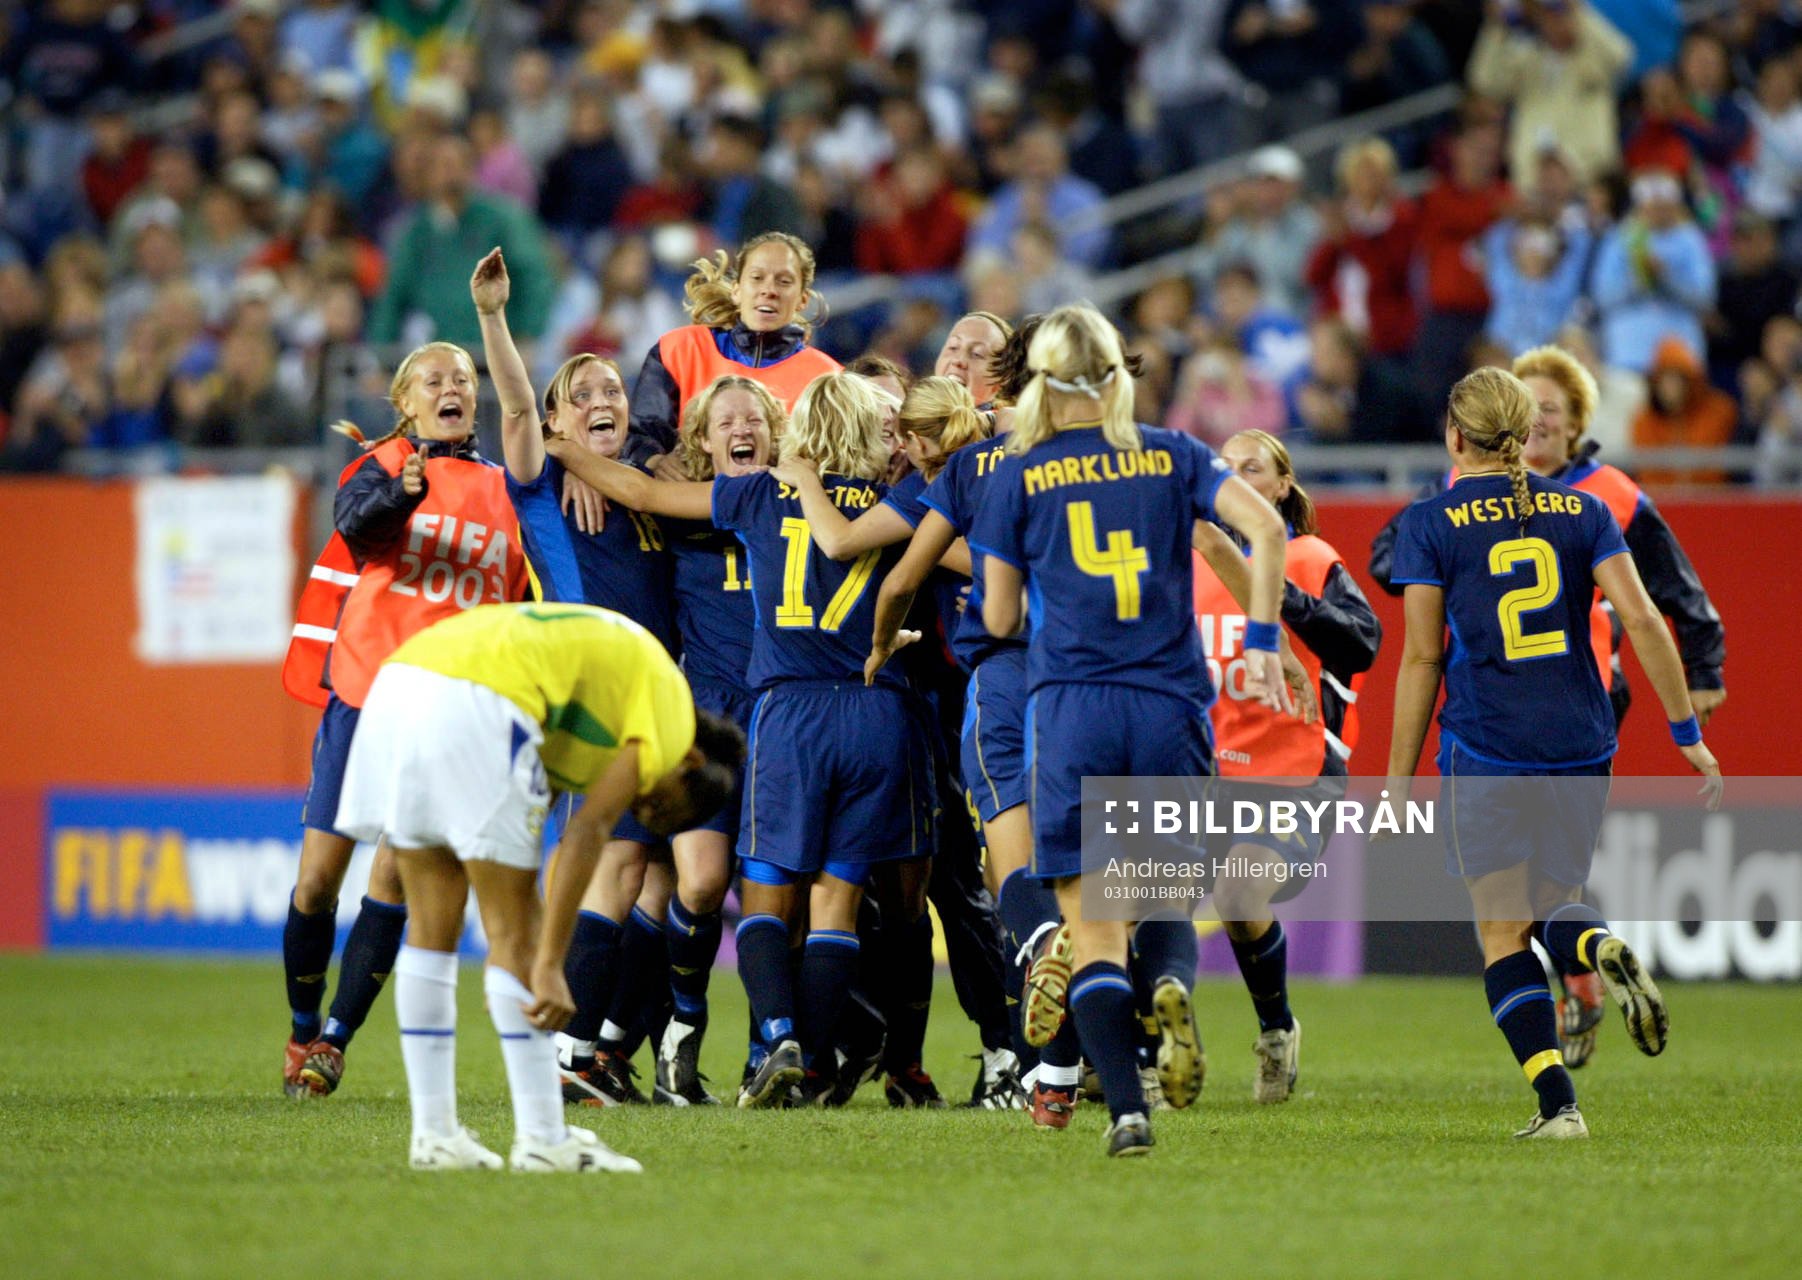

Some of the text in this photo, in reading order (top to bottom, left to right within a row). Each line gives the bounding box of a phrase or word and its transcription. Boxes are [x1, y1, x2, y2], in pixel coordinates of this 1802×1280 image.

[1023, 450, 1173, 496] MARKLUND
[407, 512, 509, 576] FIFA
[1067, 501, 1149, 621] 4
[1488, 537, 1567, 661] 2
[53, 827, 194, 923] FIFA
